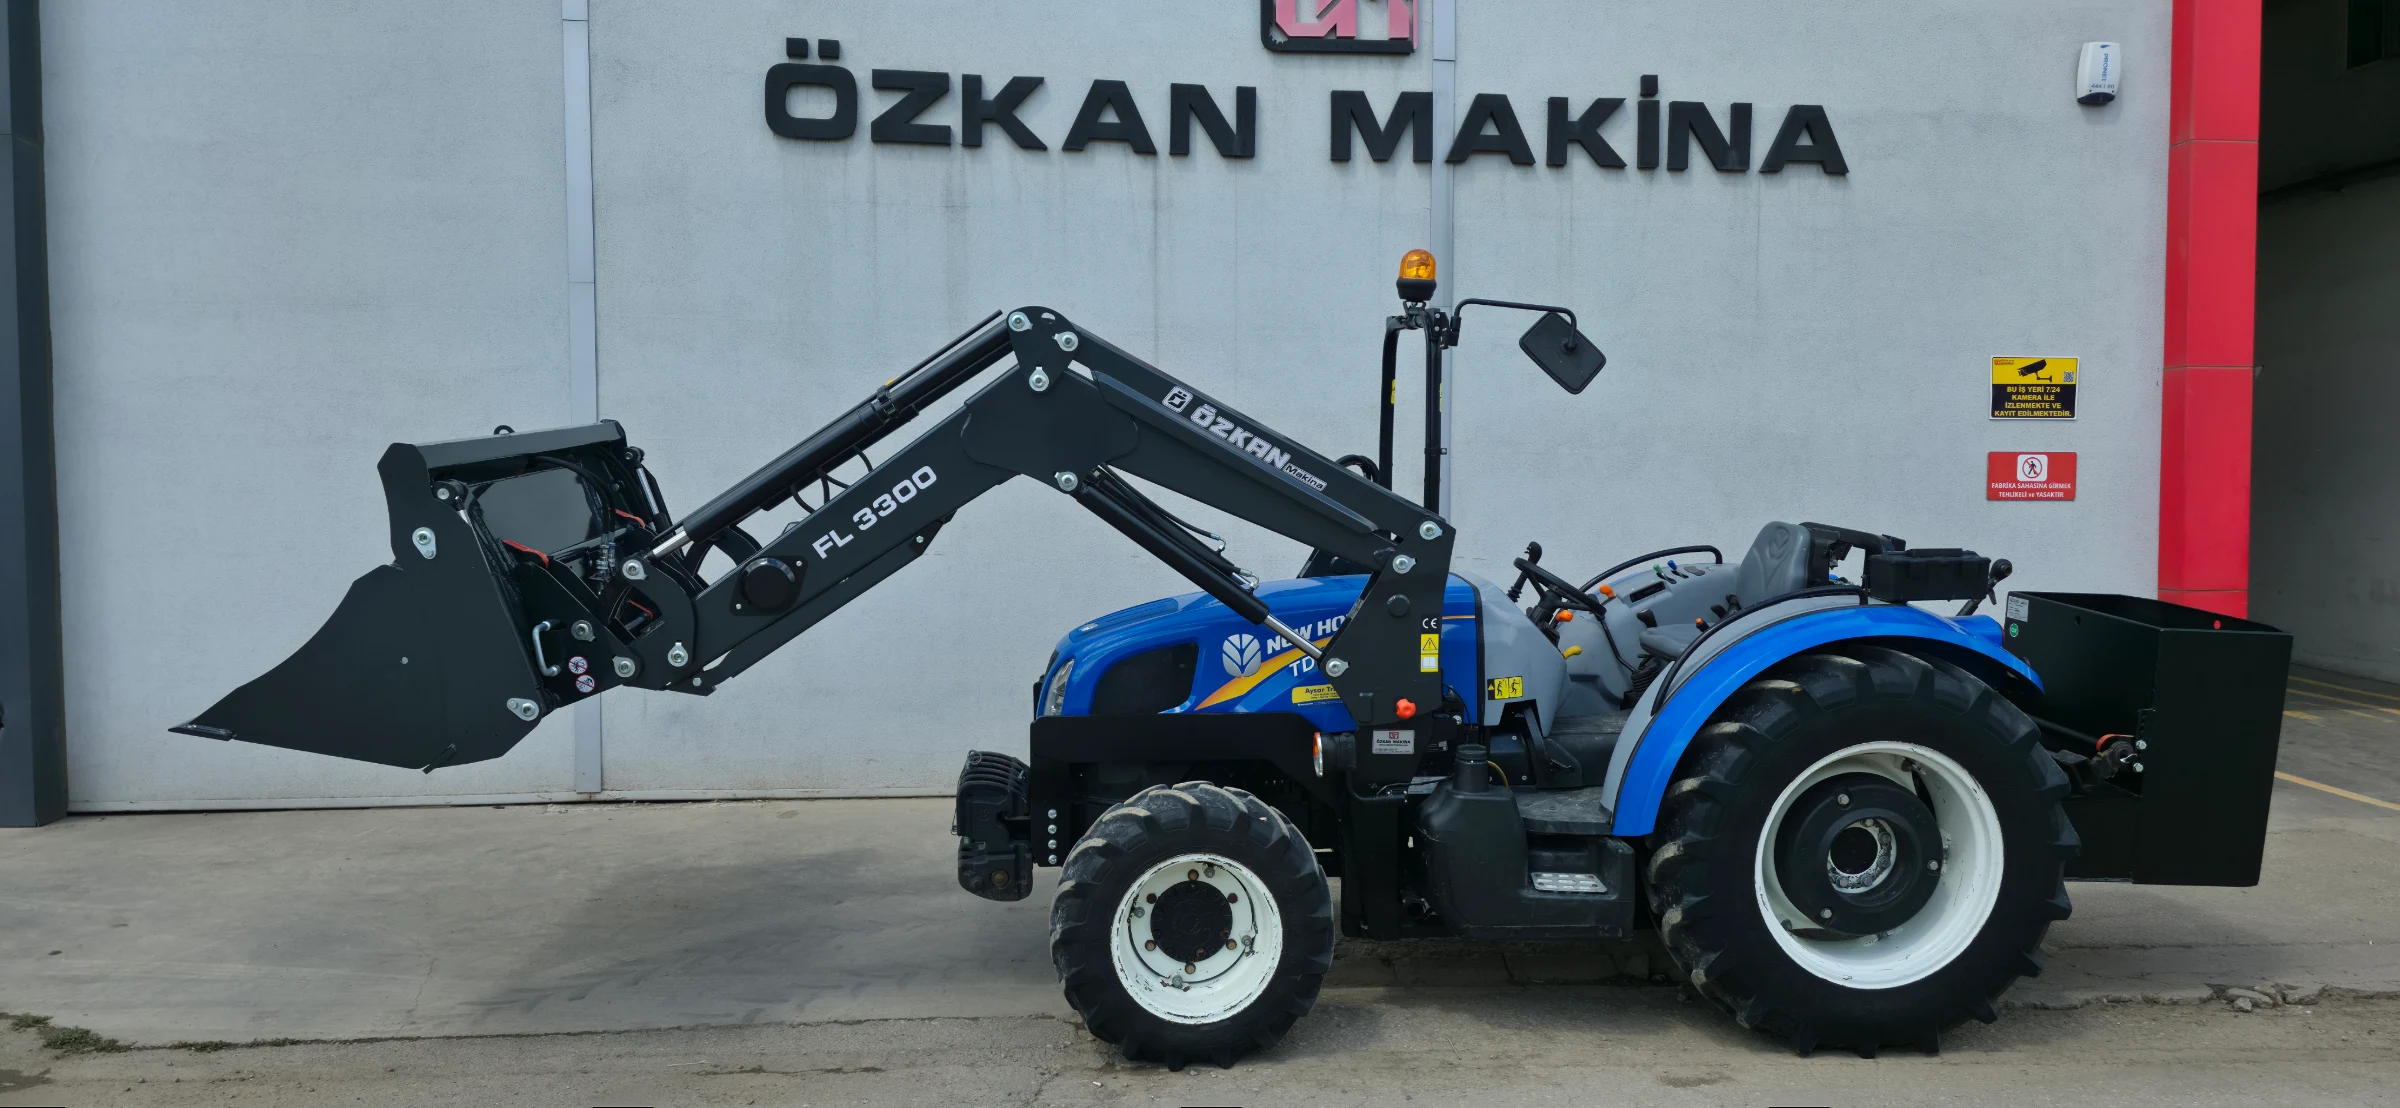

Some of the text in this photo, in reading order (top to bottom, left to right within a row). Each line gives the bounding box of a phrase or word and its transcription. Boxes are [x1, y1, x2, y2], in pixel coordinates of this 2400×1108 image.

[2101, 53, 2109, 81] PRONET
[765, 37, 1850, 174] ÖZKAN MAKİNA
[2018, 385, 2026, 394] İŞ
[2027, 385, 2044, 393] YERİ
[2005, 401, 2050, 409] İZLENMEKTE
[2017, 409, 2072, 417] EDİLMEKTEDİR.
[1190, 403, 1292, 470] ÖZKAN
[1285, 464, 1326, 490] Makina
[1991, 481, 2017, 489] FABRİKA
[811, 465, 938, 560] FL 3300
[1422, 617, 1438, 629] CE
